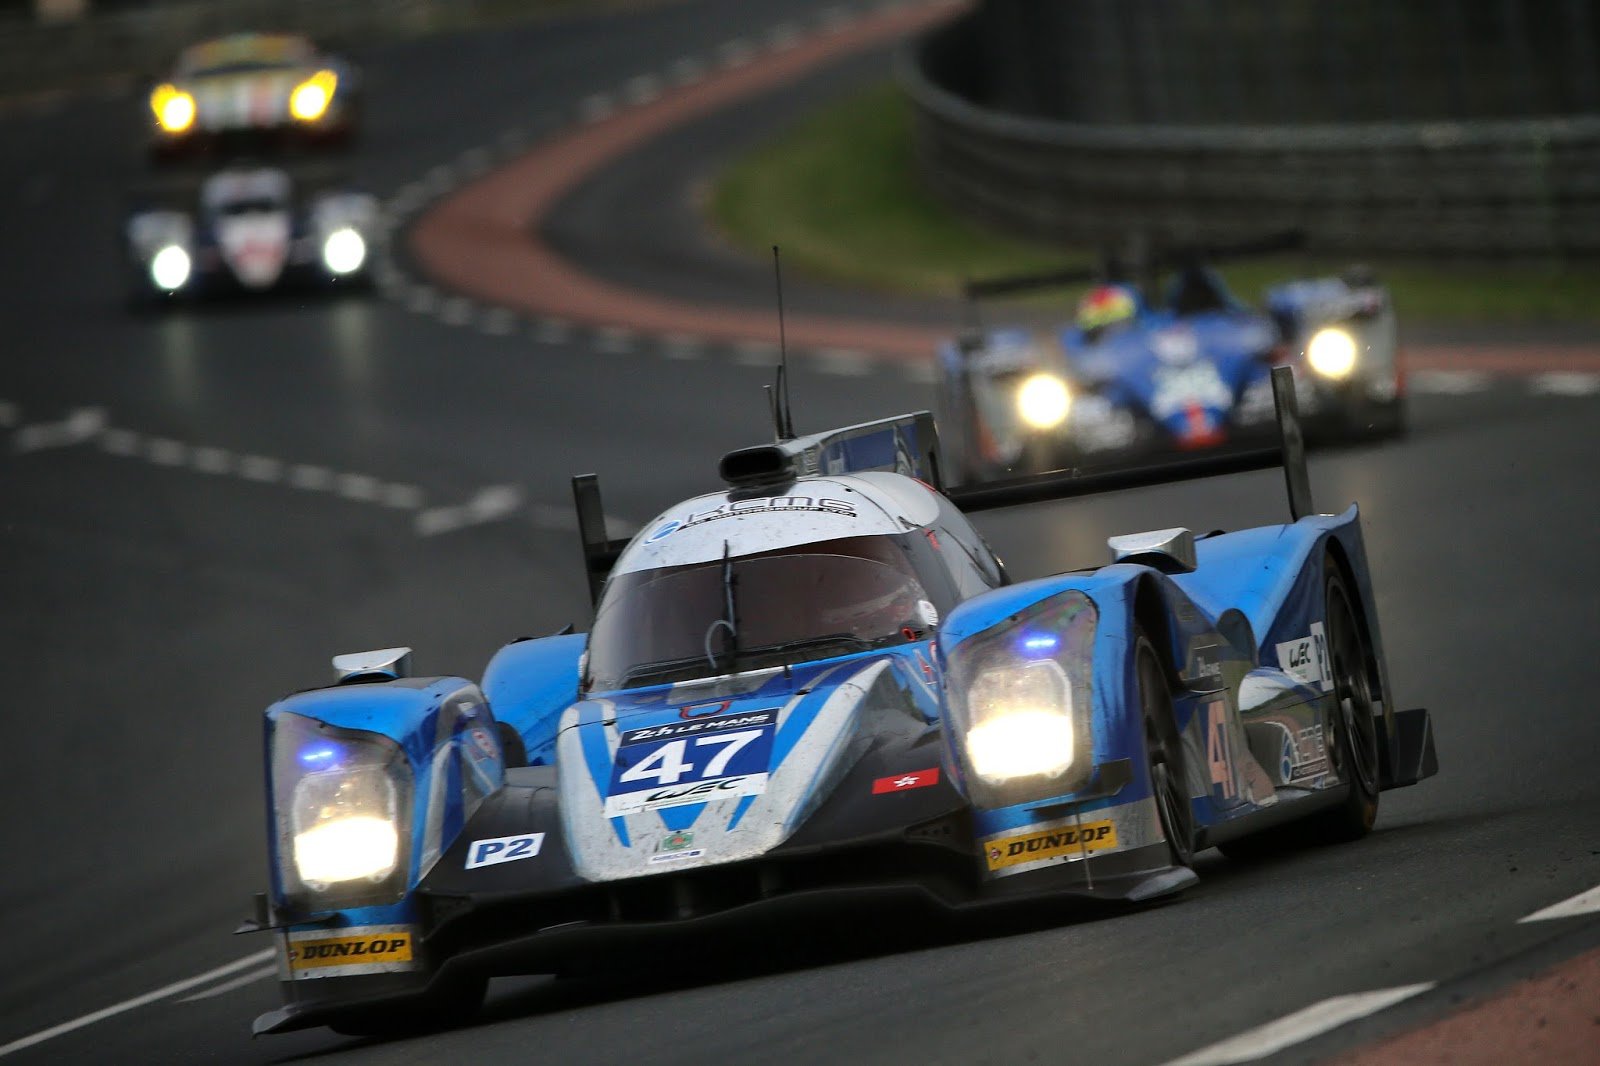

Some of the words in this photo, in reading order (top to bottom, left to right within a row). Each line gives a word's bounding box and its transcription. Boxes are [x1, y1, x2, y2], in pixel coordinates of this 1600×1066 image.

[675, 722, 704, 733] LE
[704, 713, 770, 729] MANS
[619, 729, 764, 785] 47
[645, 777, 746, 802] WEC
[473, 837, 533, 864] P2
[1007, 826, 1111, 857] DUNLOP
[302, 939, 407, 960] DUNLOP
